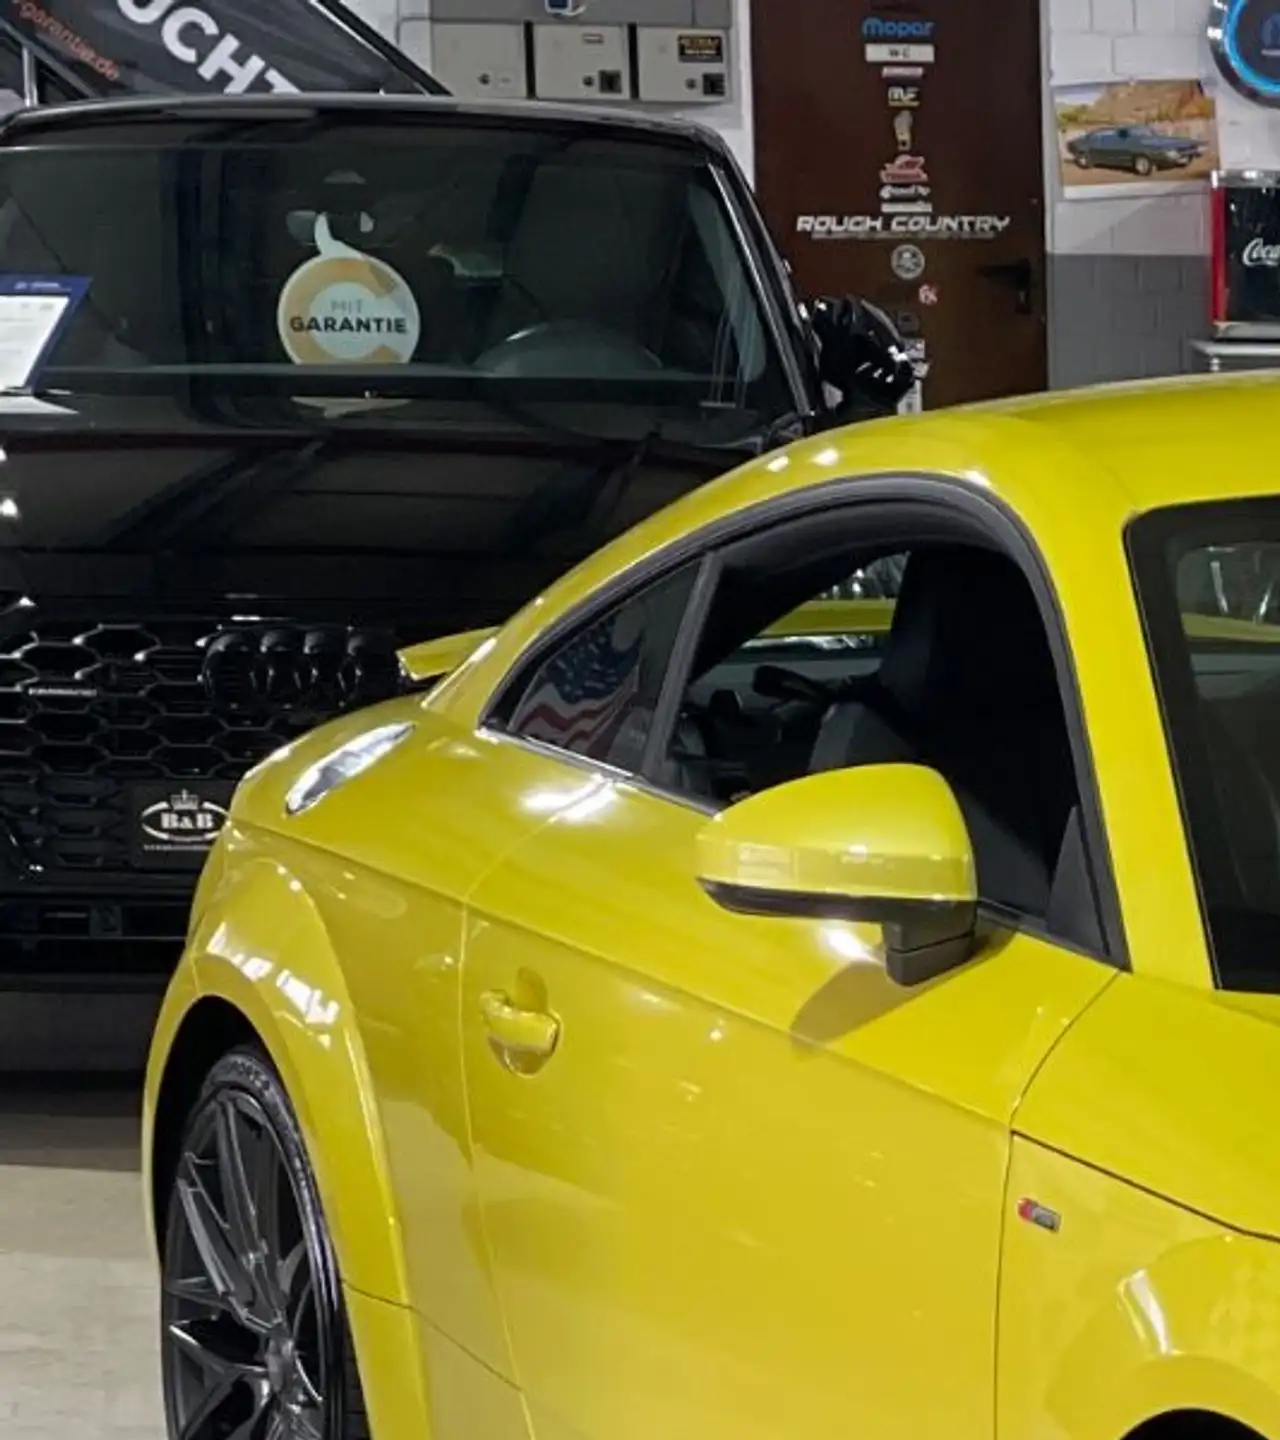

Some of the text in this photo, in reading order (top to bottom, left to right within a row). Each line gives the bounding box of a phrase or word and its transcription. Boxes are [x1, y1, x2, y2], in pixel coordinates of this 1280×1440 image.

[797, 216, 1010, 232] ROUGH COUNTRY
[290, 316, 407, 334] GARANTIE
